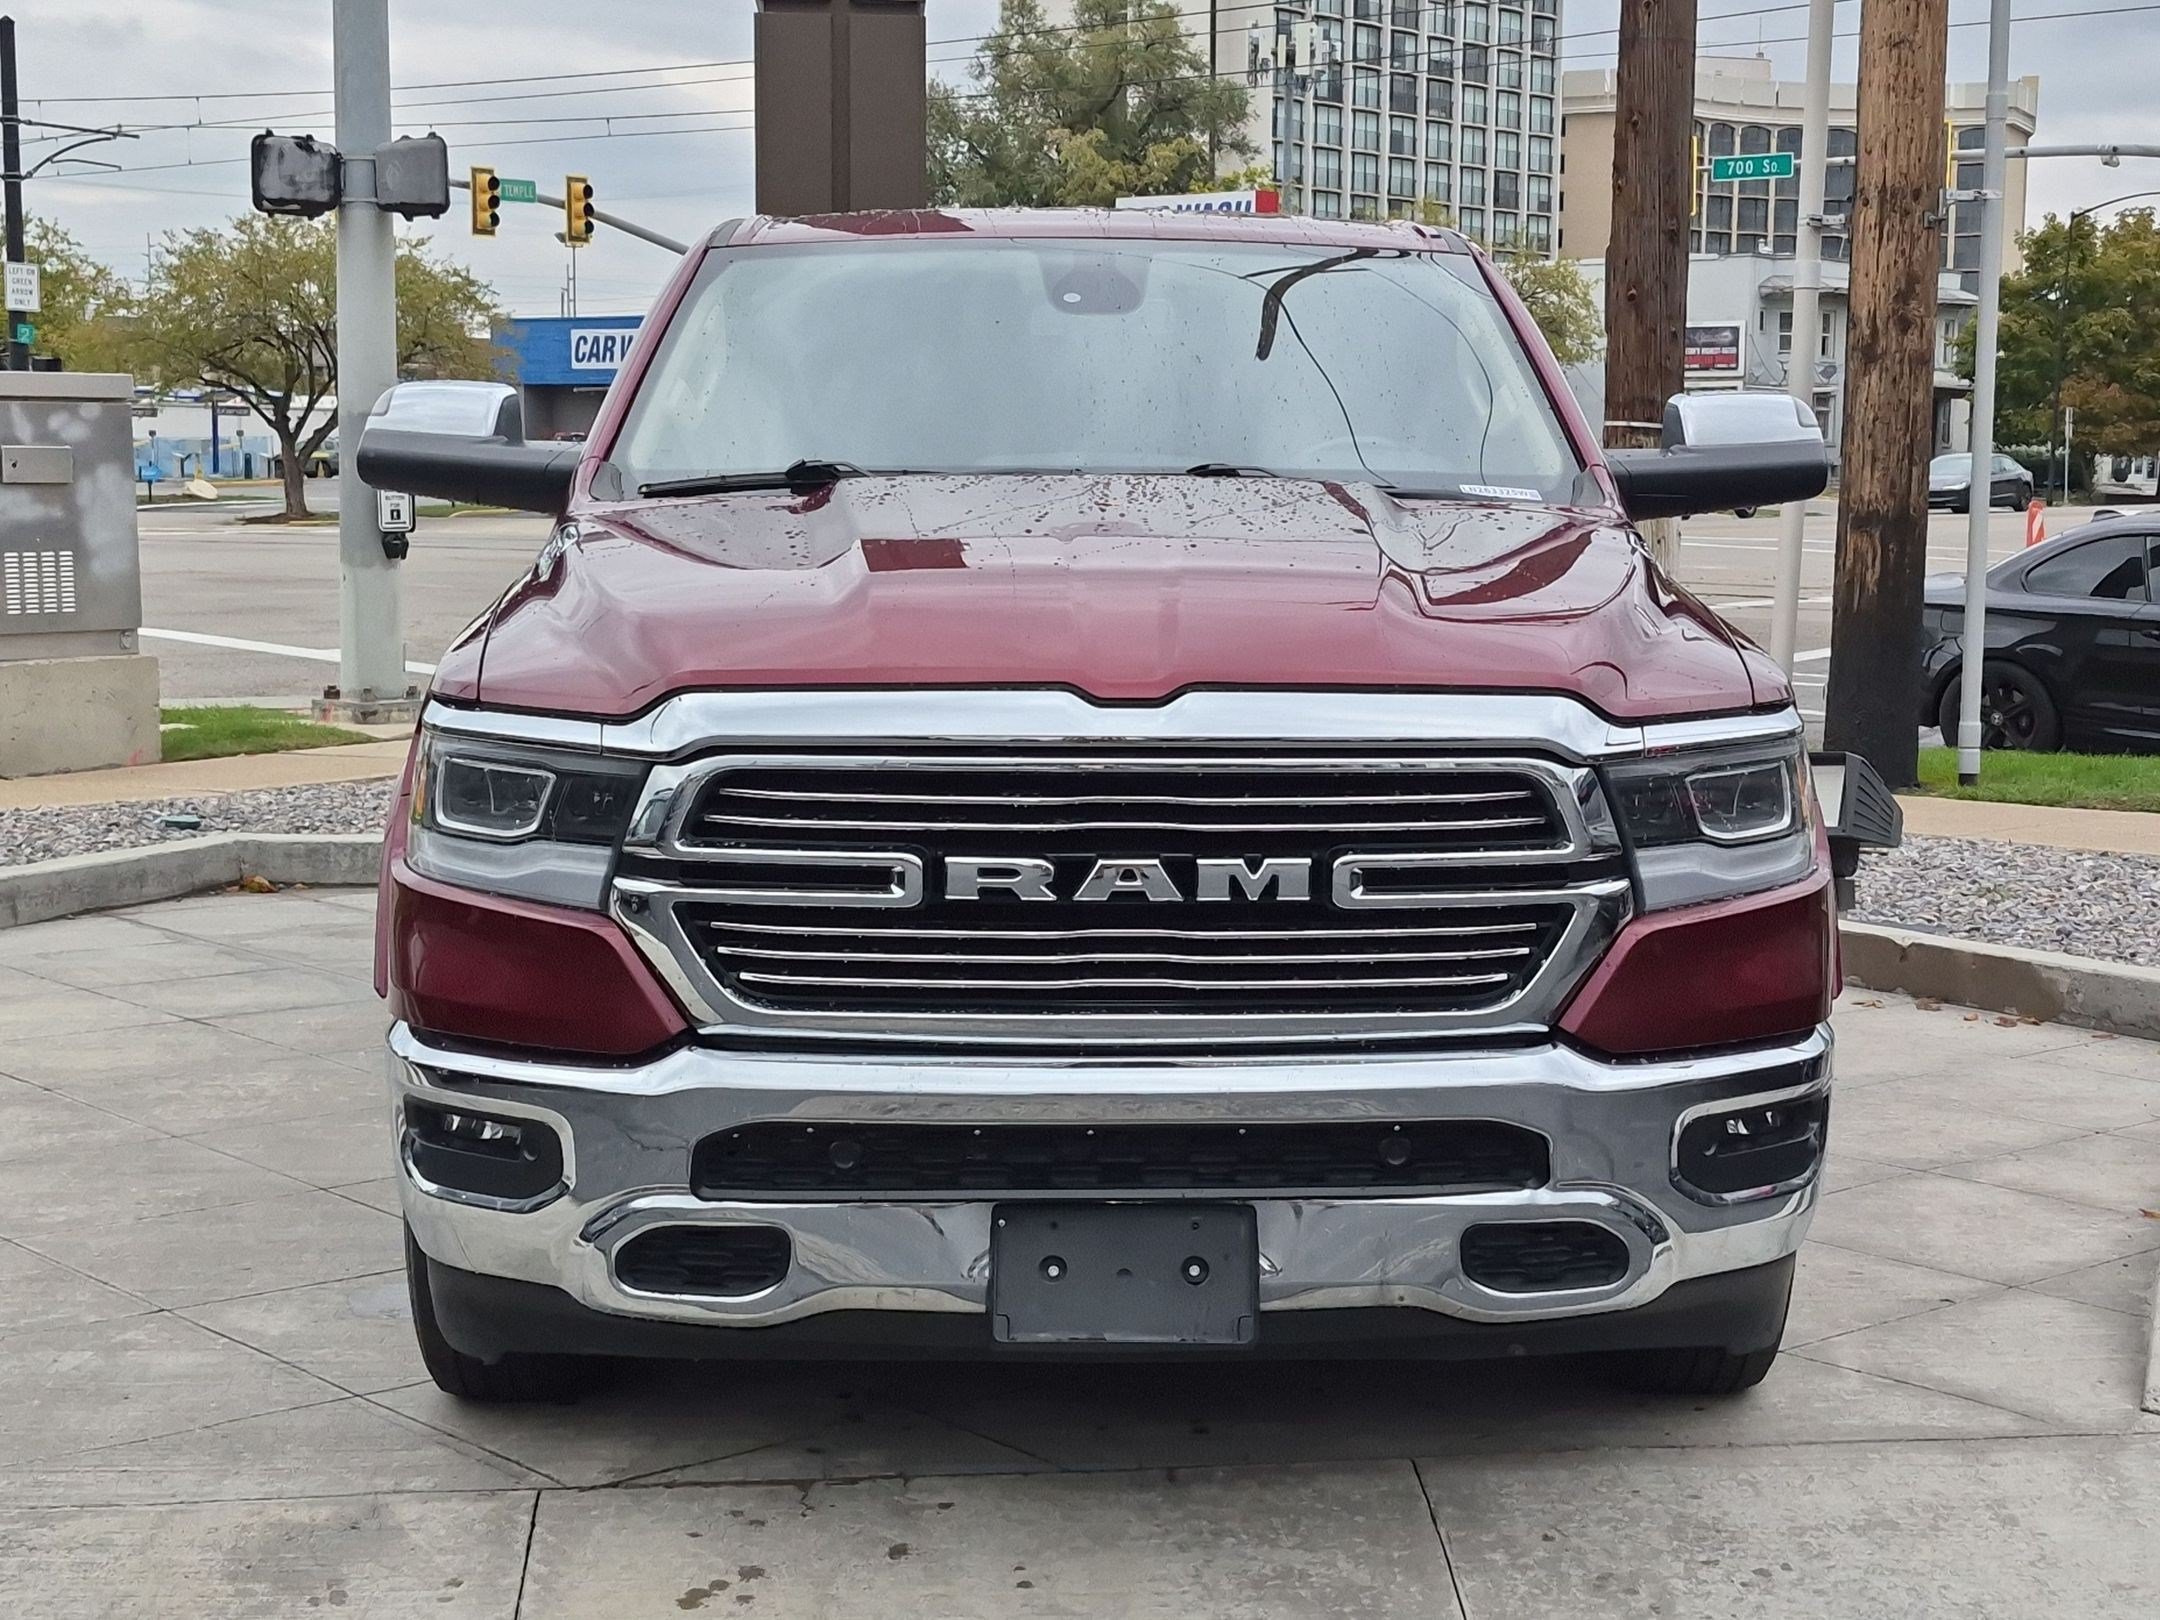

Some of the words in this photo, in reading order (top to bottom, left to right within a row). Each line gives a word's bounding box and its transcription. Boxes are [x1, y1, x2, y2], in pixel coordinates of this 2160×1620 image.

[1727, 160, 1753, 175] 700
[504, 184, 534, 198] TEMPLE
[8, 267, 23, 275] LEFT
[11, 278, 33, 286] GREEN
[11, 287, 33, 296] ARROW
[14, 298, 31, 306] ONLY
[574, 335, 617, 363] CAR
[945, 857, 1312, 901] RAM
